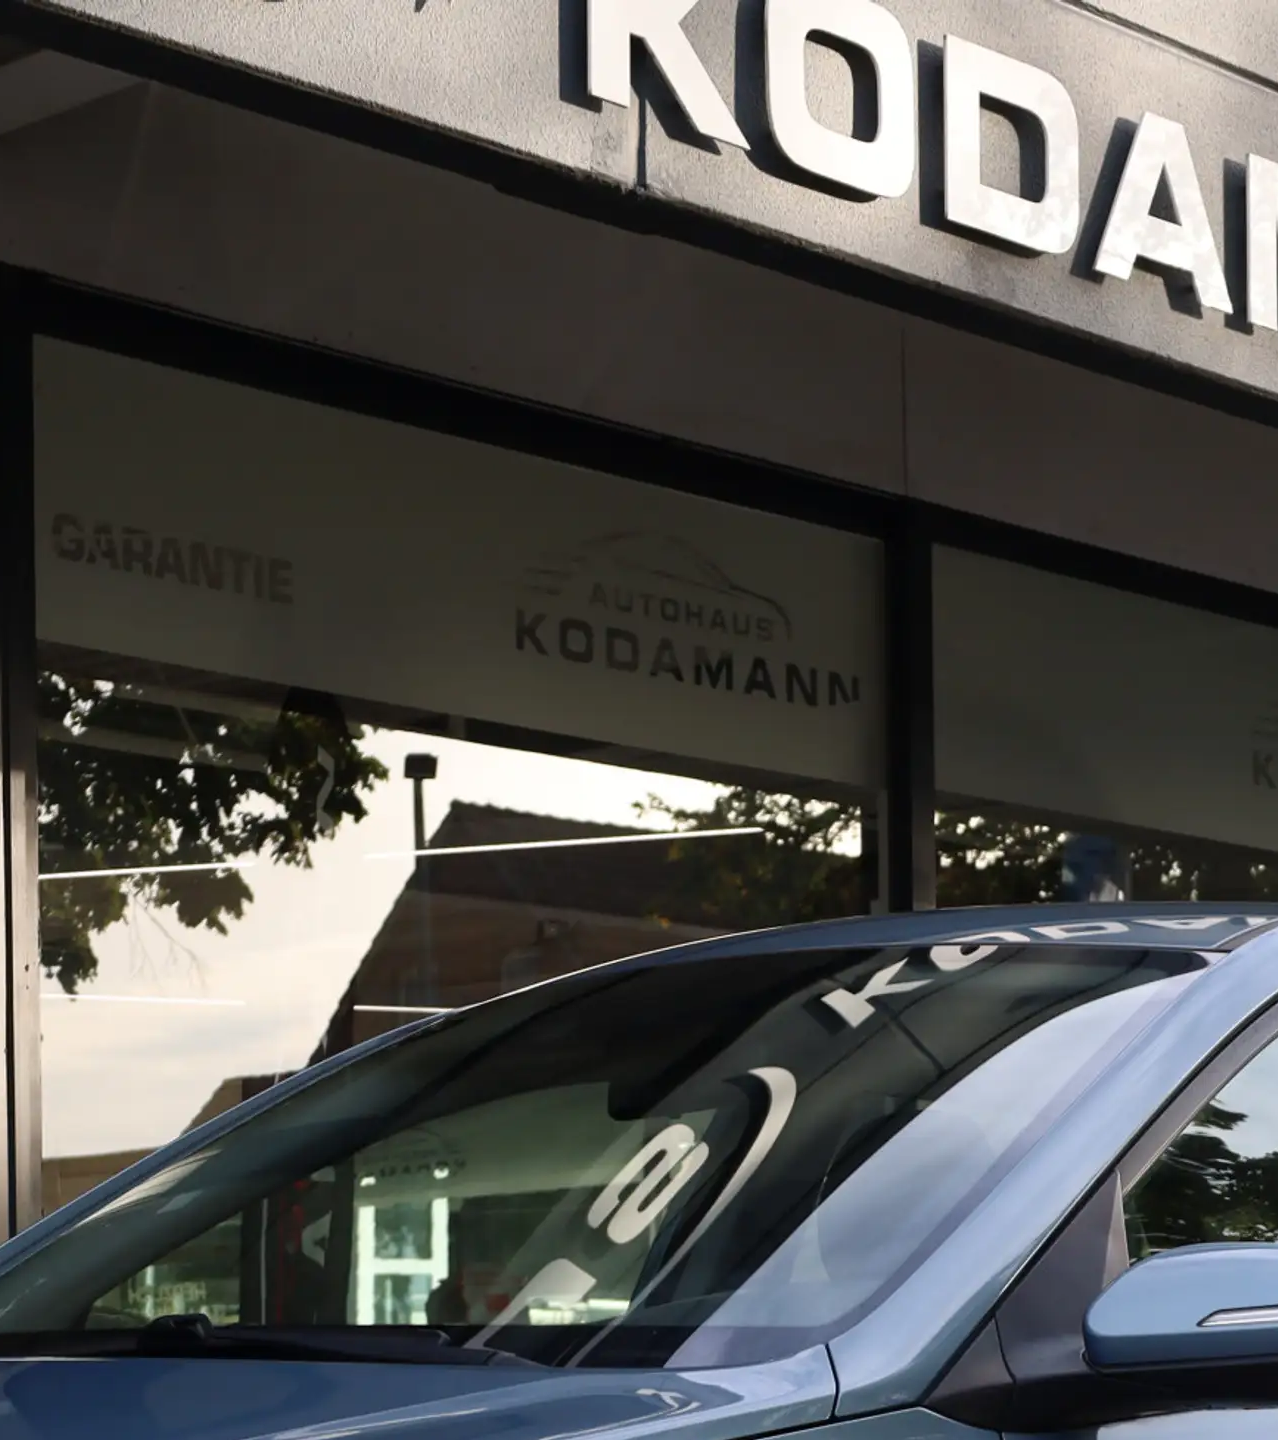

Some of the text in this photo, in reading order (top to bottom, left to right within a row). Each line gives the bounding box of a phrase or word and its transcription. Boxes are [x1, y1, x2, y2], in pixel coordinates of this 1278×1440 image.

[50, 511, 295, 605] GARANTIE
[514, 606, 861, 708] KODAMANN
[587, 581, 776, 643] AUTOHAUS
